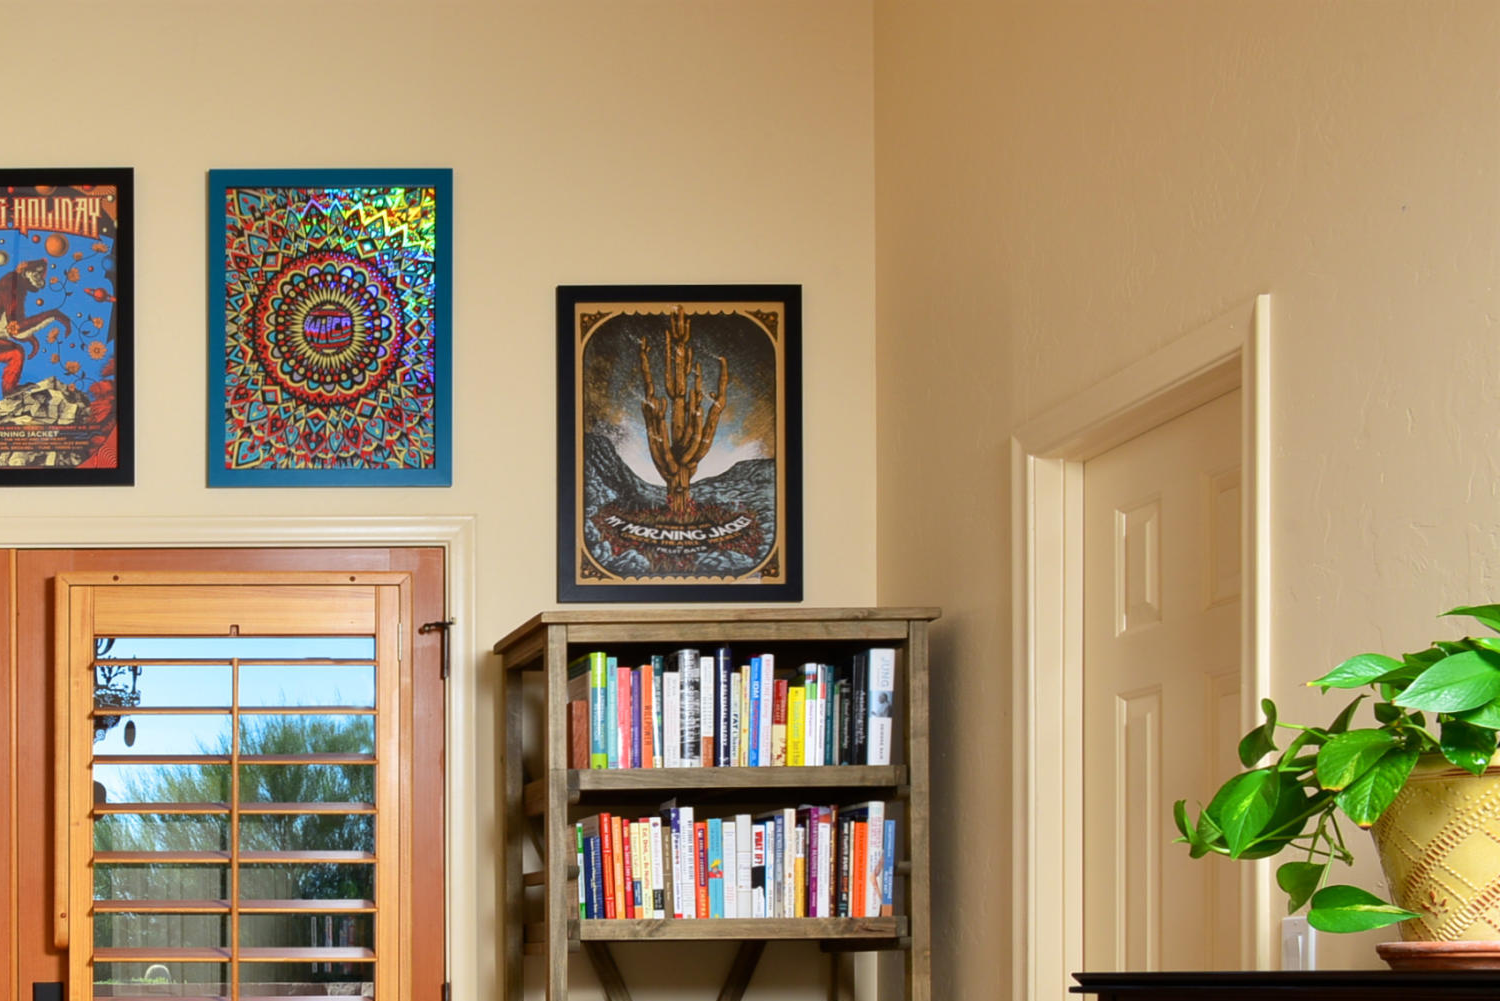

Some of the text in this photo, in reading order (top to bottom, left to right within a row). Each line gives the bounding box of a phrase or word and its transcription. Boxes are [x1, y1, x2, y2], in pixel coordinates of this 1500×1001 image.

[12, 196, 102, 241] HOLIDAY
[26, 430, 59, 438] JACKET
[604, 515, 626, 528] MY
[621, 522, 709, 541] MORNING
[708, 514, 752, 539] JACKET
[880, 656, 890, 688] JUNG
[754, 831, 763, 851] WHAT
